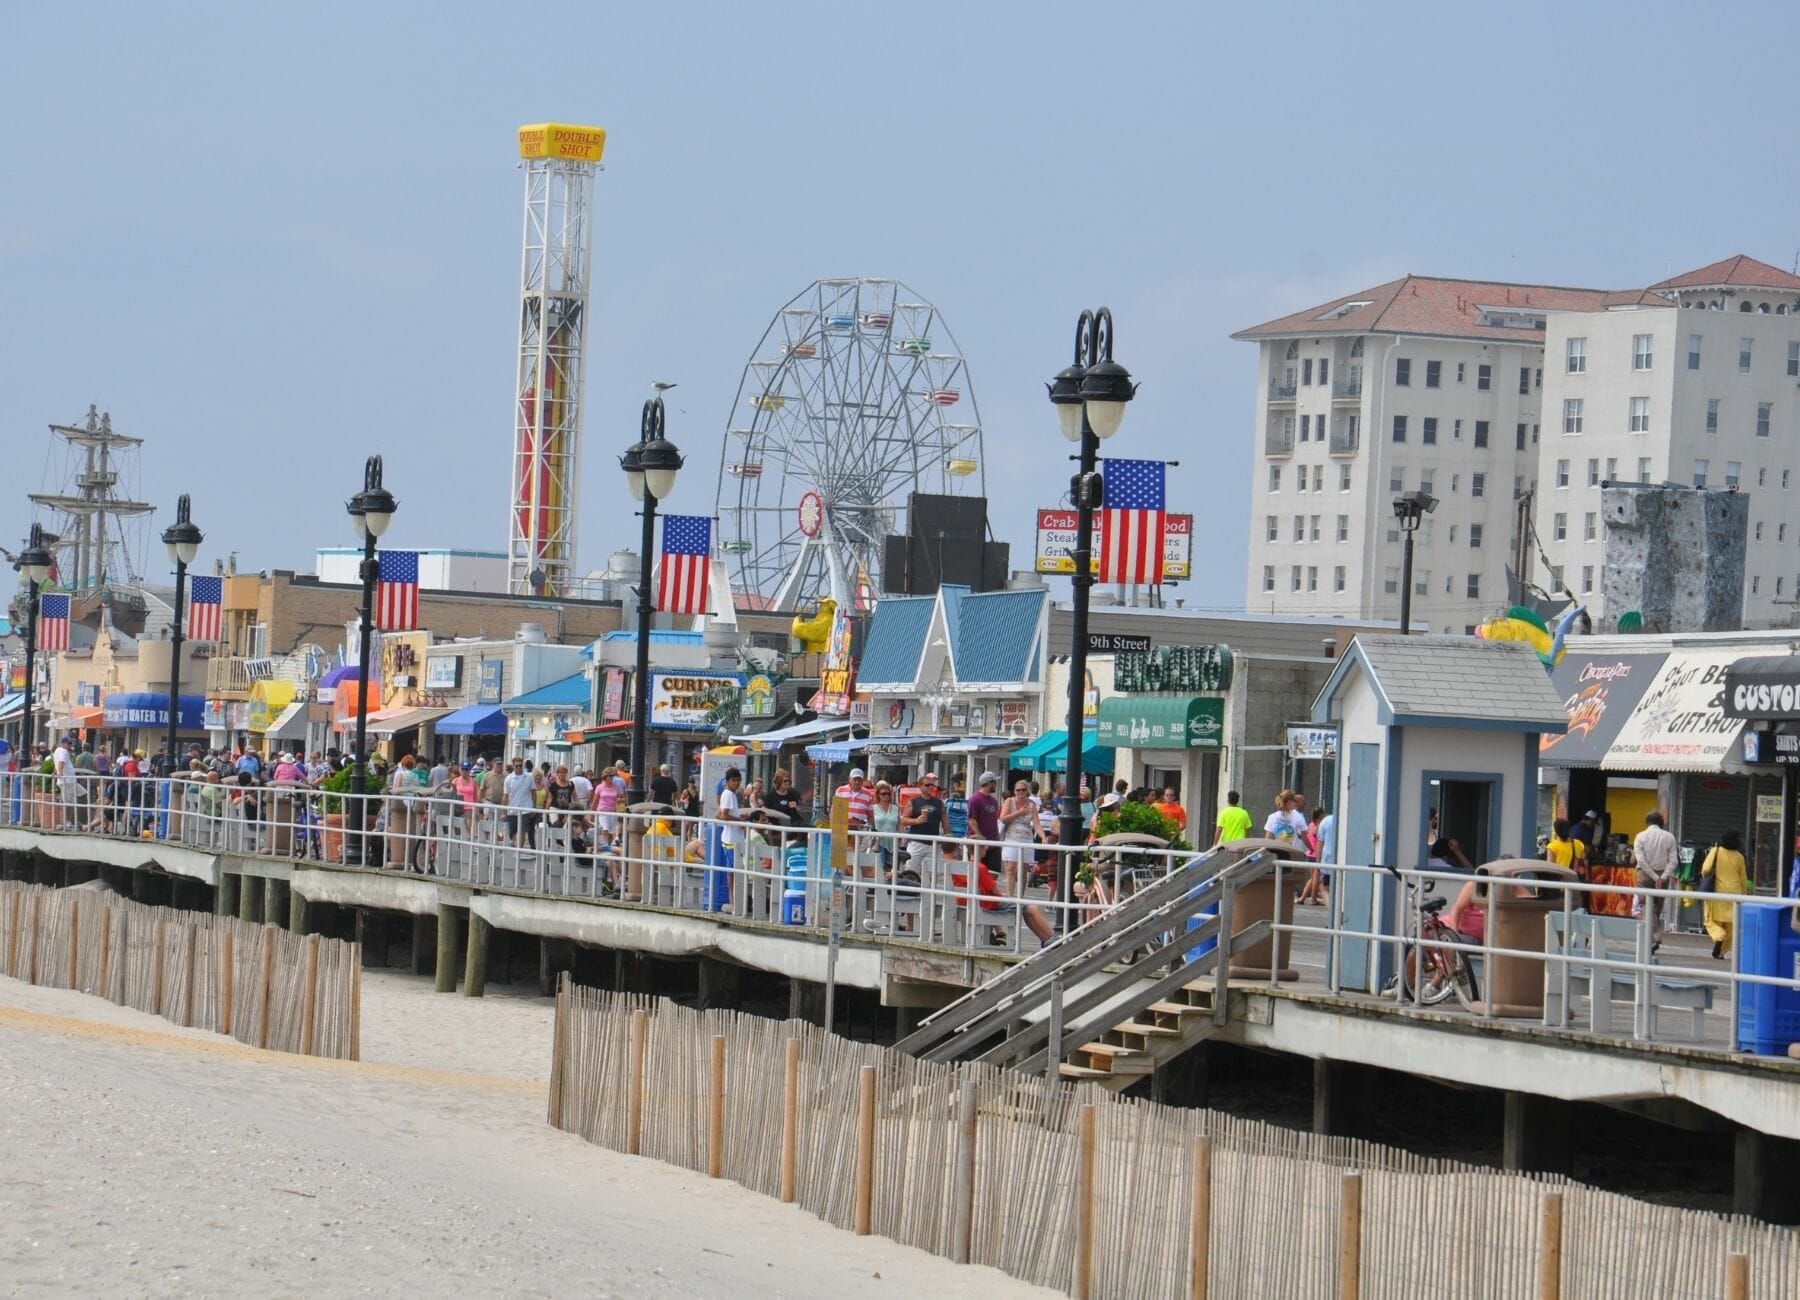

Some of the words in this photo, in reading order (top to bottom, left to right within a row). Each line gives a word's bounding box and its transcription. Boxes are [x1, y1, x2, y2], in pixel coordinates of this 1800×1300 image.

[520, 130, 544, 142] DOUBLE
[555, 131, 600, 145] DOUBLE
[525, 142, 541, 153] SHOT
[560, 144, 591, 156] SHOT
[1043, 515, 1075, 527] Crab
[1090, 636, 1110, 648] 9th
[1113, 637, 1148, 651] Street
[246, 660, 273, 676] VINYL
[662, 677, 733, 692] CURLY'S
[1668, 667, 1700, 693] HUT
[158, 710, 184, 724] TAY
[1668, 711, 1706, 733] GIFT
[1699, 711, 1743, 734] SHOP
[1776, 755, 1787, 764] UP
[1788, 755, 1799, 764] TO
